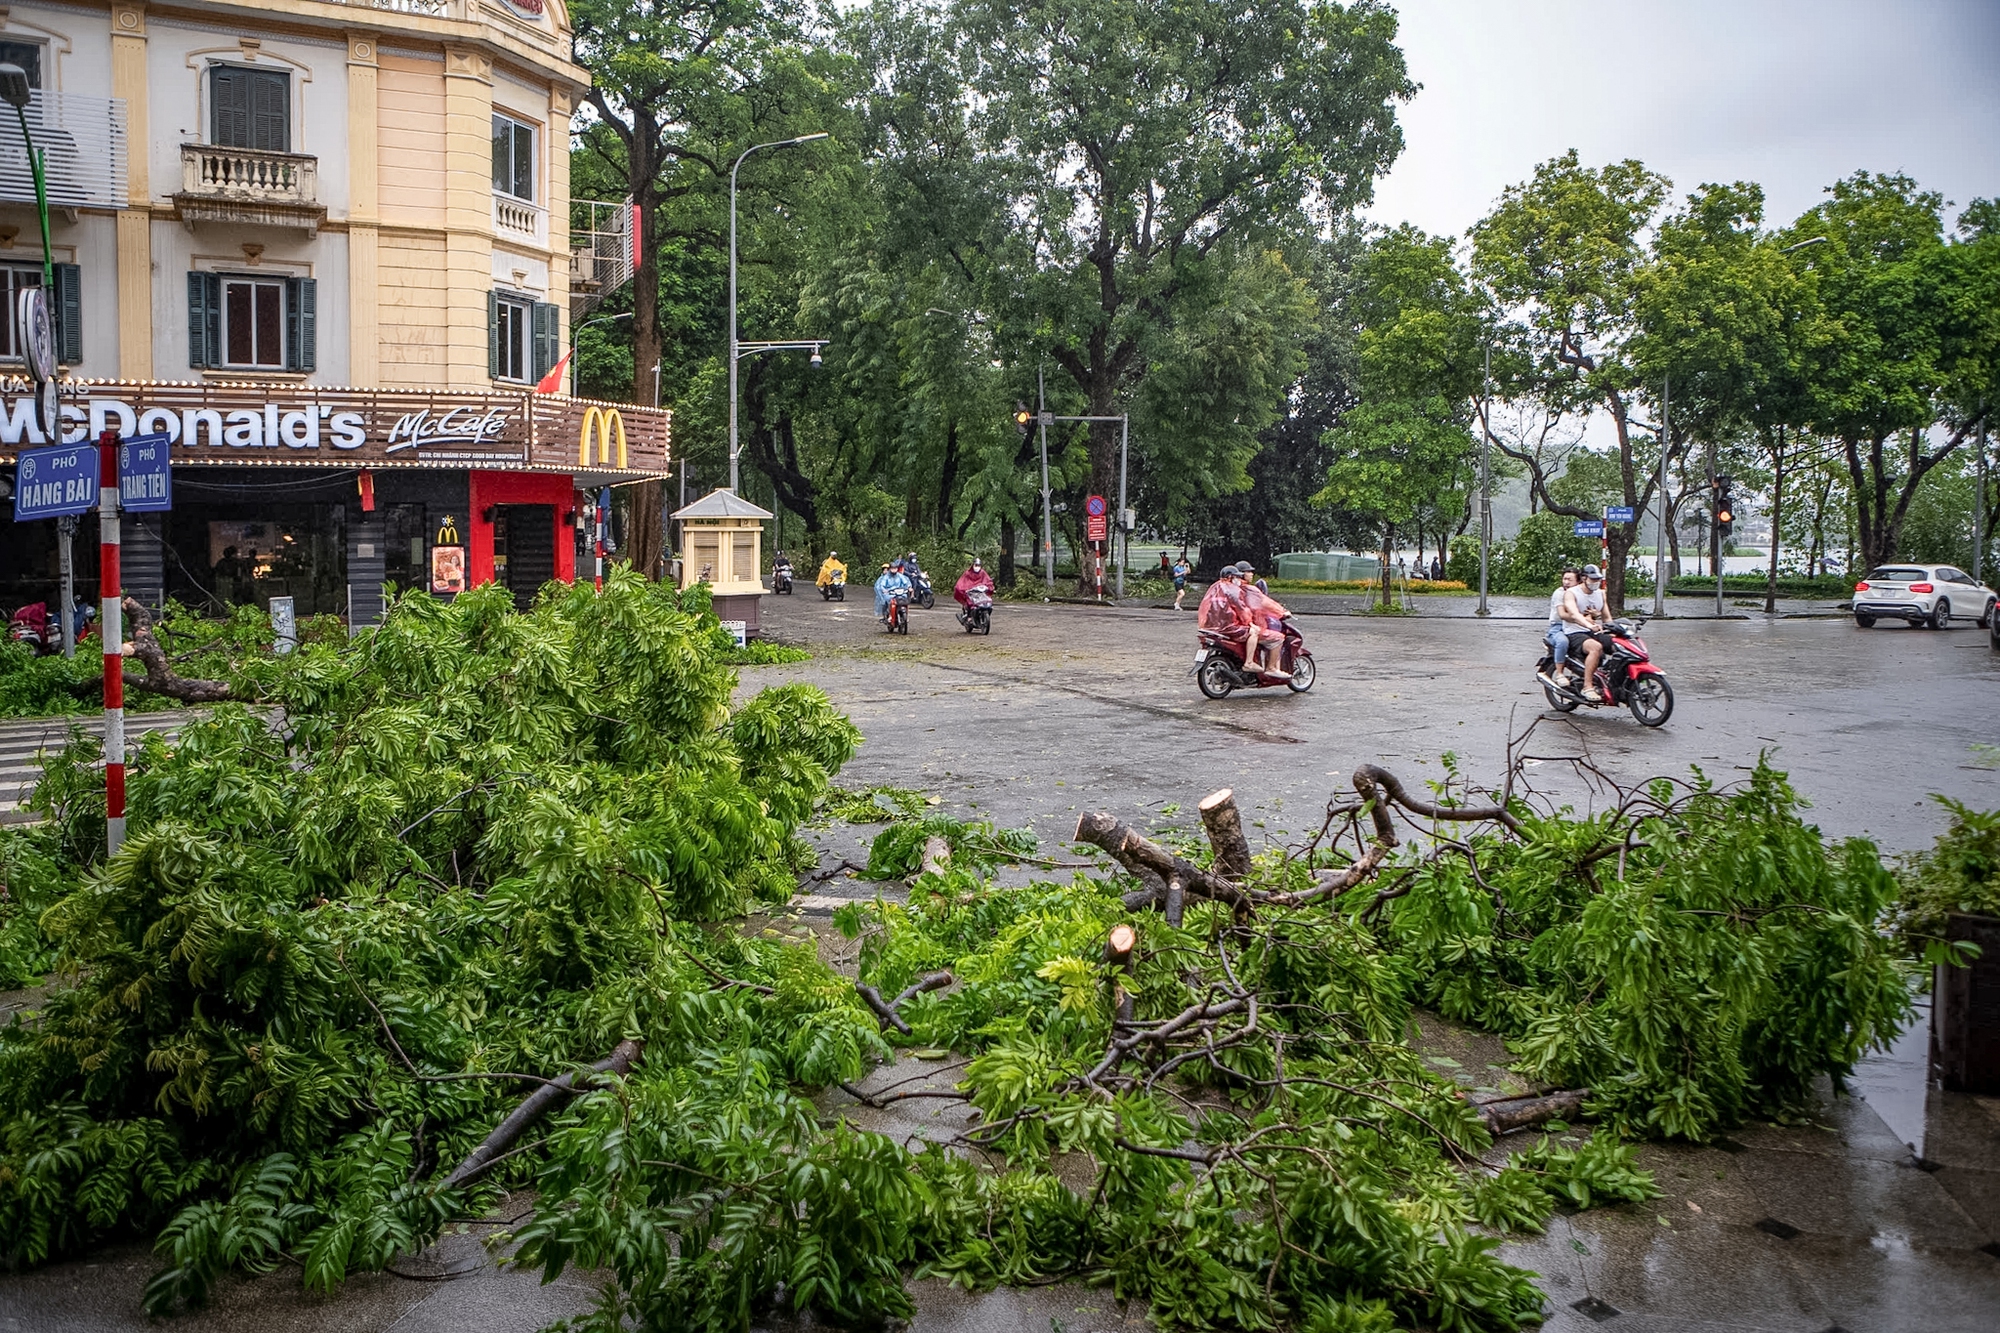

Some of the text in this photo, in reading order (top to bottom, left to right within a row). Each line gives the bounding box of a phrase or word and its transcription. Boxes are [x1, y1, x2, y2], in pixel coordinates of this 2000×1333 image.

[34, 380, 89, 394] NG
[0, 398, 366, 449] McDonald's
[52, 450, 78, 469] PHỐ
[139, 443, 156, 461] PHỐ
[22, 473, 92, 508] HÀNG BÀI
[122, 465, 166, 499] TRÀNG TIỀN
